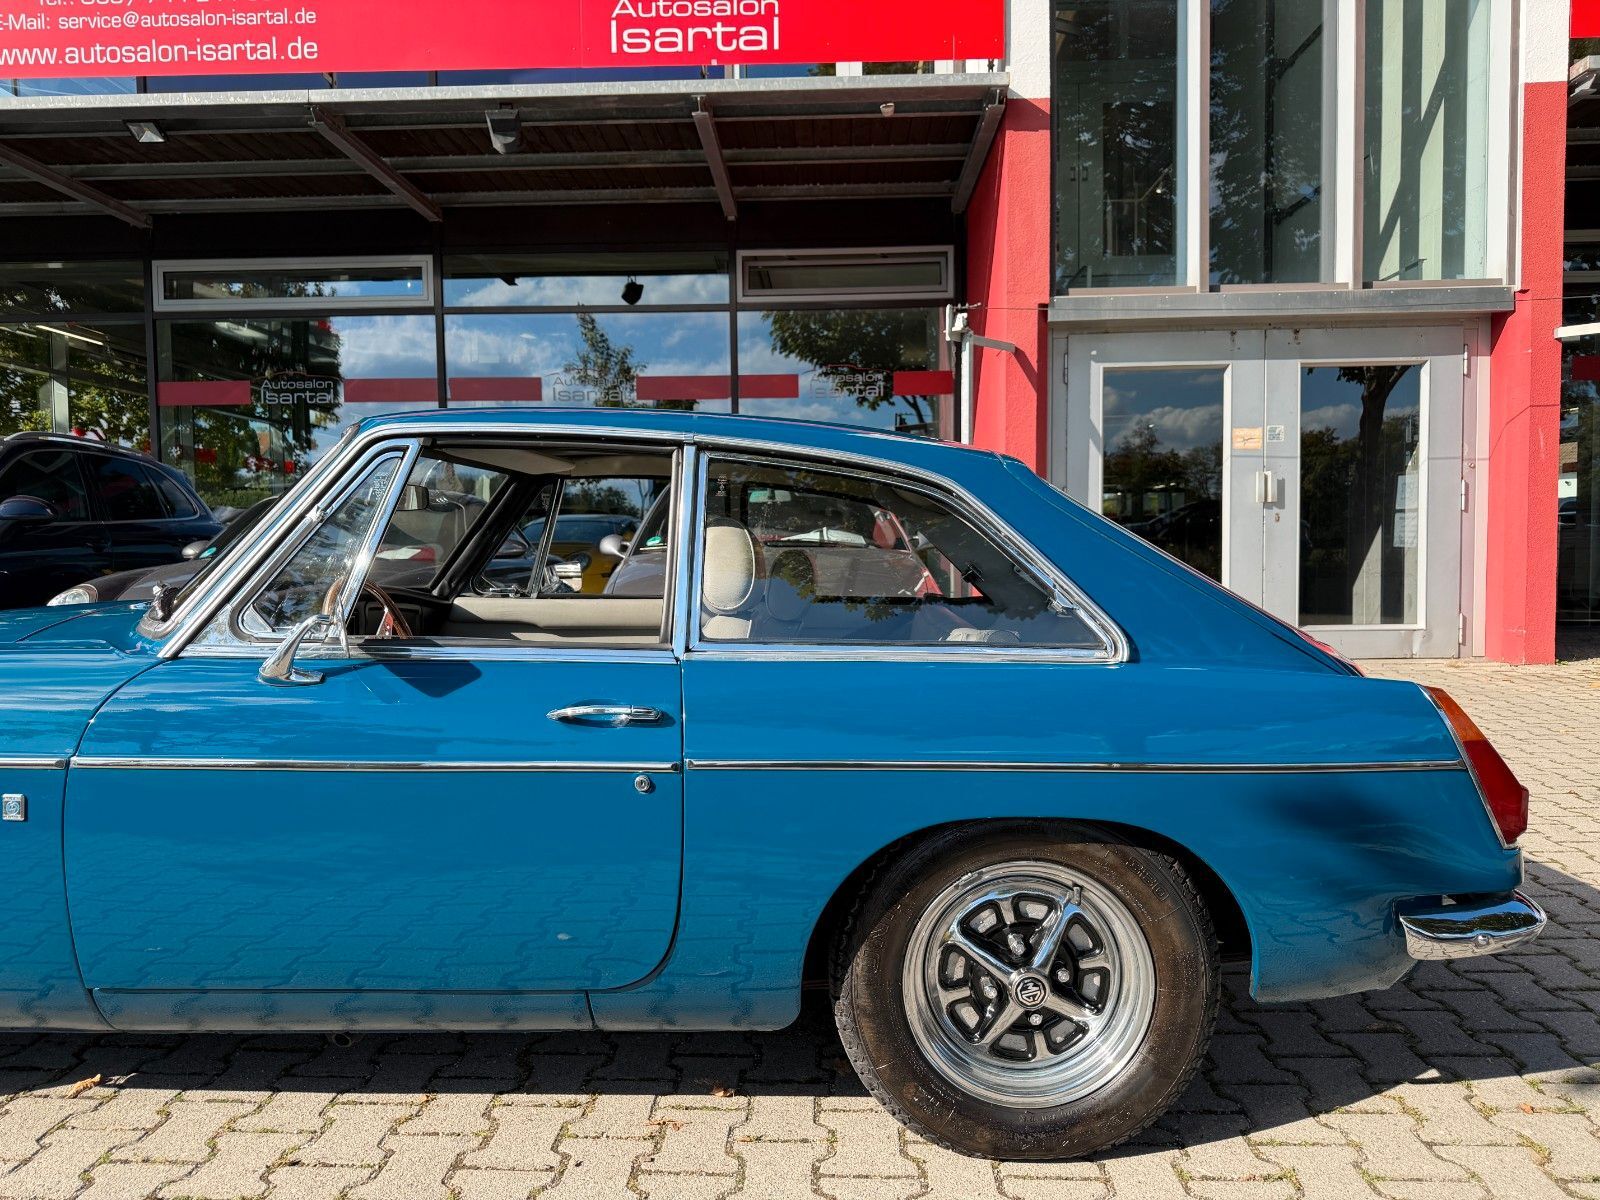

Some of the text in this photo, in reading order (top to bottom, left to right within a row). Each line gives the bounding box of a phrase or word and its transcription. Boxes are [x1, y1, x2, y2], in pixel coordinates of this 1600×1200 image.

[611, 0, 779, 18] Autosalon
[58, 9, 317, 30] service@autosalon-isartal.de
[610, 17, 780, 53] Isartal
[261, 379, 333, 389] Autosalon
[261, 389, 334, 404] Isartal
[1019, 980, 1042, 1003] MG
